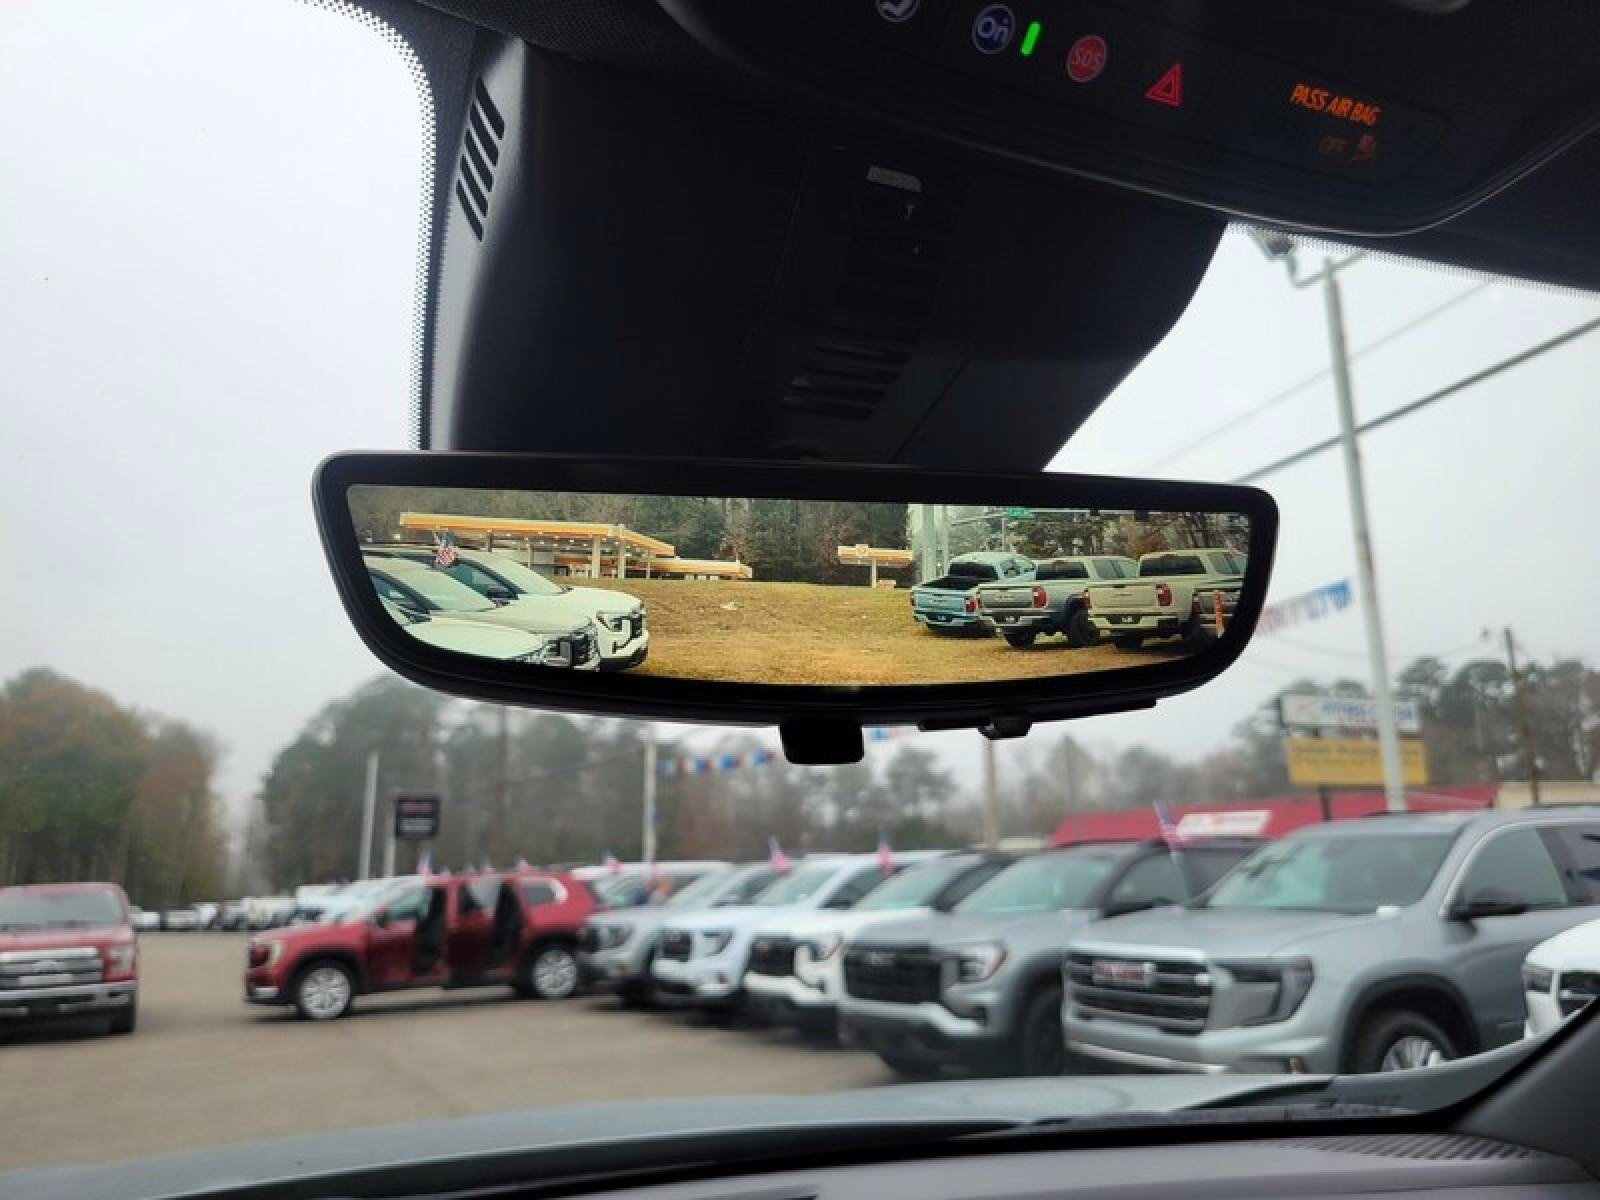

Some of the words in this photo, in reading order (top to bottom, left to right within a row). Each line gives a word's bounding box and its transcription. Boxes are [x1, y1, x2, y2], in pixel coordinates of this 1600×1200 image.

[1070, 47, 1104, 69] SOS
[1290, 83, 1328, 111] PASS
[1325, 95, 1353, 118] AIR
[1350, 101, 1381, 126] BAG
